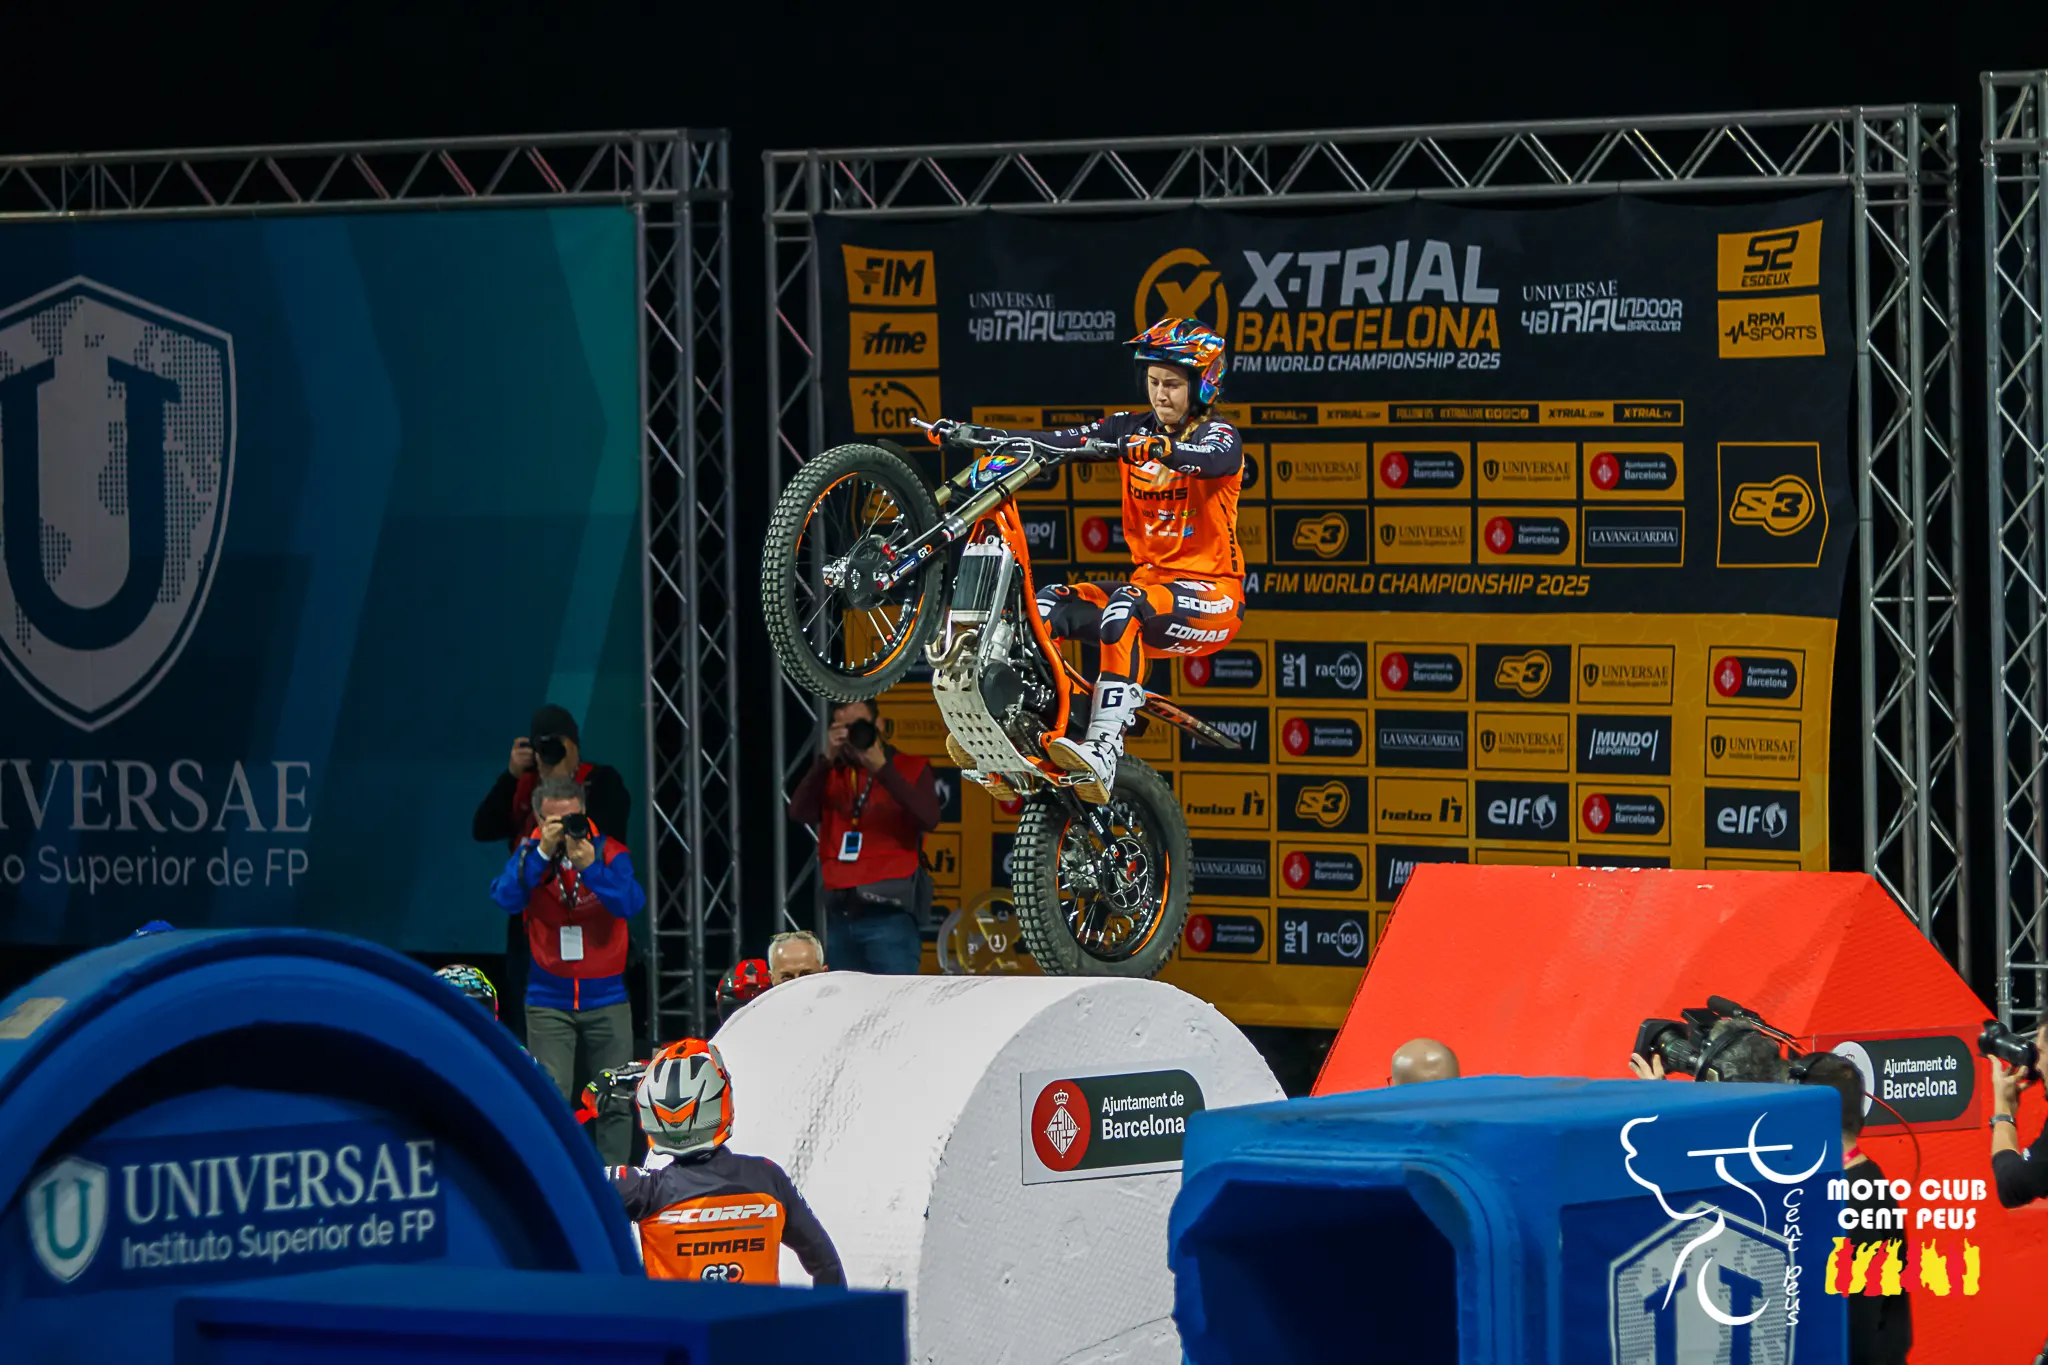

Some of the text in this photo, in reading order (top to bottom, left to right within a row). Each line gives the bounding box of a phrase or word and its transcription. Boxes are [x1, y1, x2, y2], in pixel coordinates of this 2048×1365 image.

[1742, 272, 1790, 287] ESDEUX
[968, 291, 1055, 309] UNIVERSAE
[1522, 279, 1618, 301] UNIVERSAE
[1619, 296, 1683, 318] INDOOR
[1057, 309, 1116, 329] INDOOR
[1235, 306, 1500, 352] BARCELONA
[1747, 312, 1785, 326] RPM
[1750, 325, 1817, 341] SPORTS
[1232, 352, 1501, 372] FIM WORLD CHAMPIONSHIP 2025
[872, 400, 919, 429] fcm
[1413, 469, 1454, 479] Barcelona
[1624, 470, 1667, 480] Barcelona
[1518, 534, 1560, 545] Barcelona
[1264, 573, 1299, 592] FIM
[1303, 573, 1375, 593] WORLD
[1378, 573, 1534, 594] CHAMPIONSHIP
[1536, 575, 1590, 596] 2025
[1165, 623, 1230, 642] COMAS
[1413, 671, 1453, 682] Barcelona
[1602, 665, 1668, 678] UNIVERSAE
[1747, 676, 1788, 688] Barcelona
[1597, 731, 1653, 748] MUNDO
[1729, 737, 1797, 753] UNIVERSAE
[1487, 797, 1531, 826] elf
[1615, 813, 1656, 825] Barcelona
[1717, 805, 1762, 834] elf
[38, 844, 196, 895] Superior
[206, 846, 254, 887] de
[265, 848, 309, 887] FP
[1883, 1056, 1957, 1077] Ajuntament de
[1883, 1079, 1957, 1100] Barcelona
[1102, 1091, 1184, 1117] Ajuntament de
[1102, 1114, 1186, 1140] Barcelona
[122, 1140, 439, 1226] UNIVERSAE
[658, 1203, 778, 1225] SCORPA
[121, 1208, 436, 1270] Instituto Superior de FP
[676, 1237, 765, 1257] COMAS
